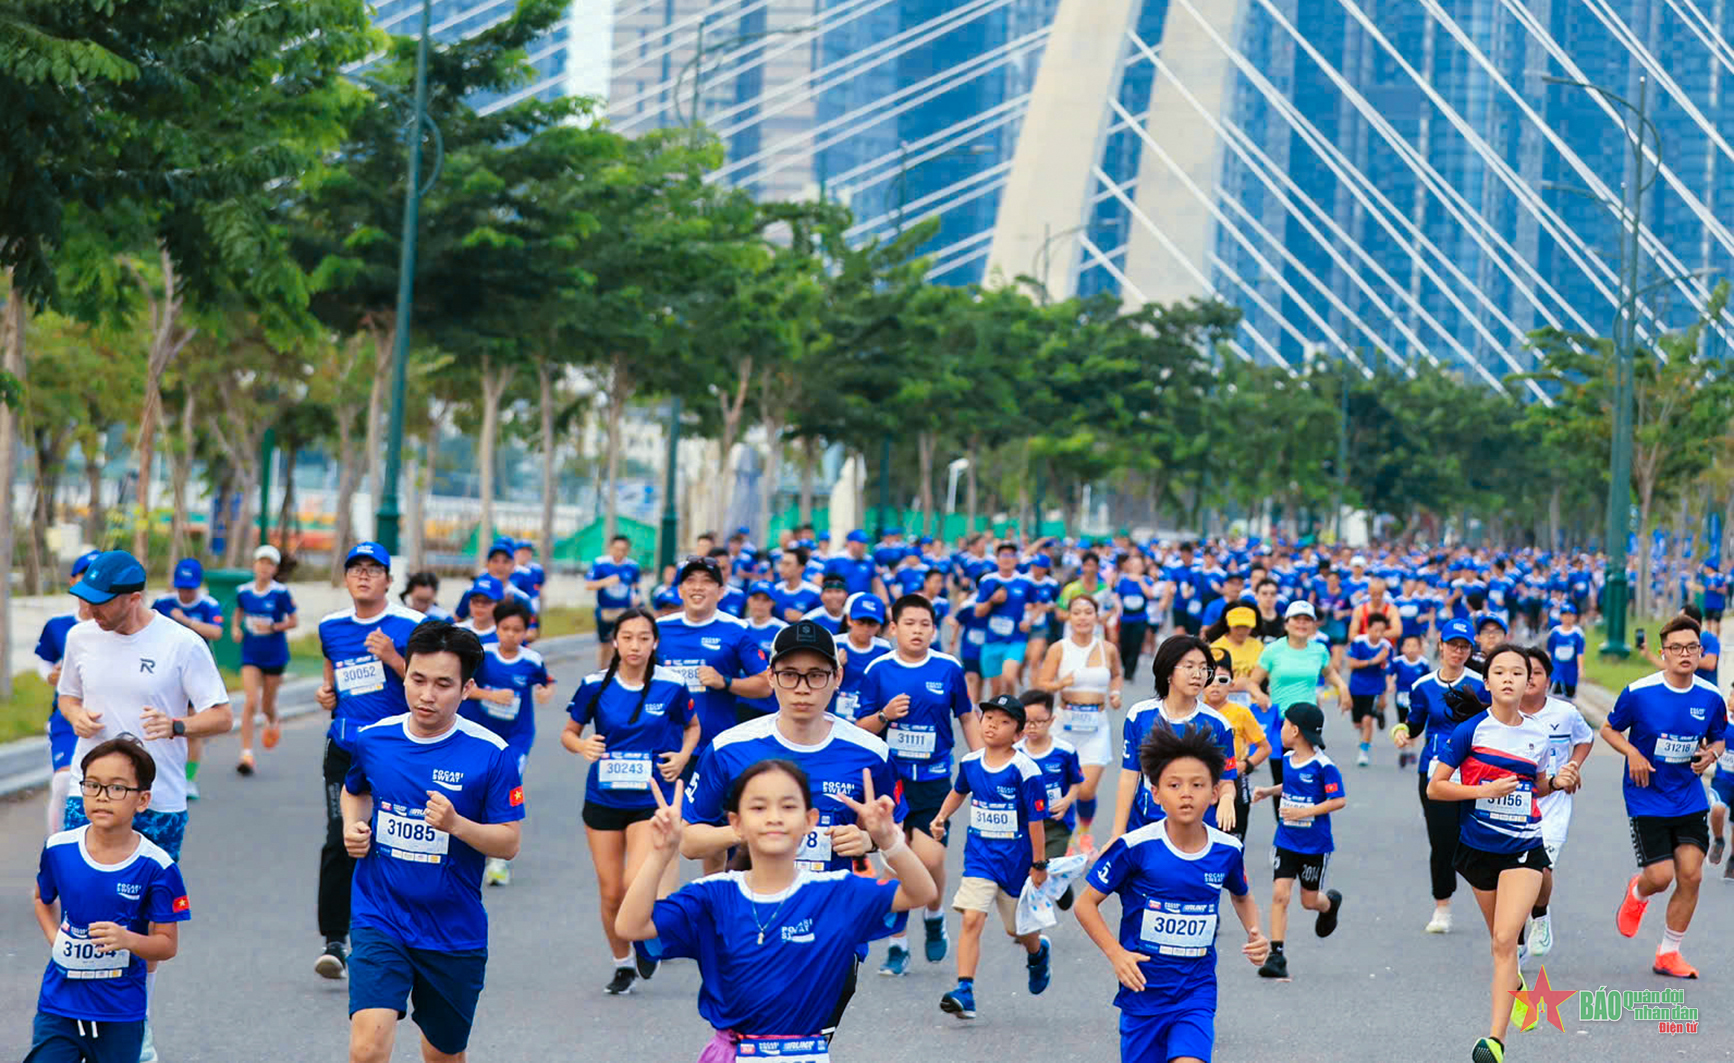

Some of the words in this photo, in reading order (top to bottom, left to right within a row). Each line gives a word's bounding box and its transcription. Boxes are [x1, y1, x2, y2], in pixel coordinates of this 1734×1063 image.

[343, 665, 377, 682] 30052
[897, 732, 925, 745] 31111
[1664, 742, 1691, 754] 31218
[432, 769, 464, 779] POCARI
[607, 762, 643, 774] 30243
[432, 774, 460, 783] SWEAT
[822, 781, 855, 790] POCARI
[976, 810, 1008, 825] 31460
[388, 818, 435, 841] 31085
[1154, 916, 1207, 937] 30207
